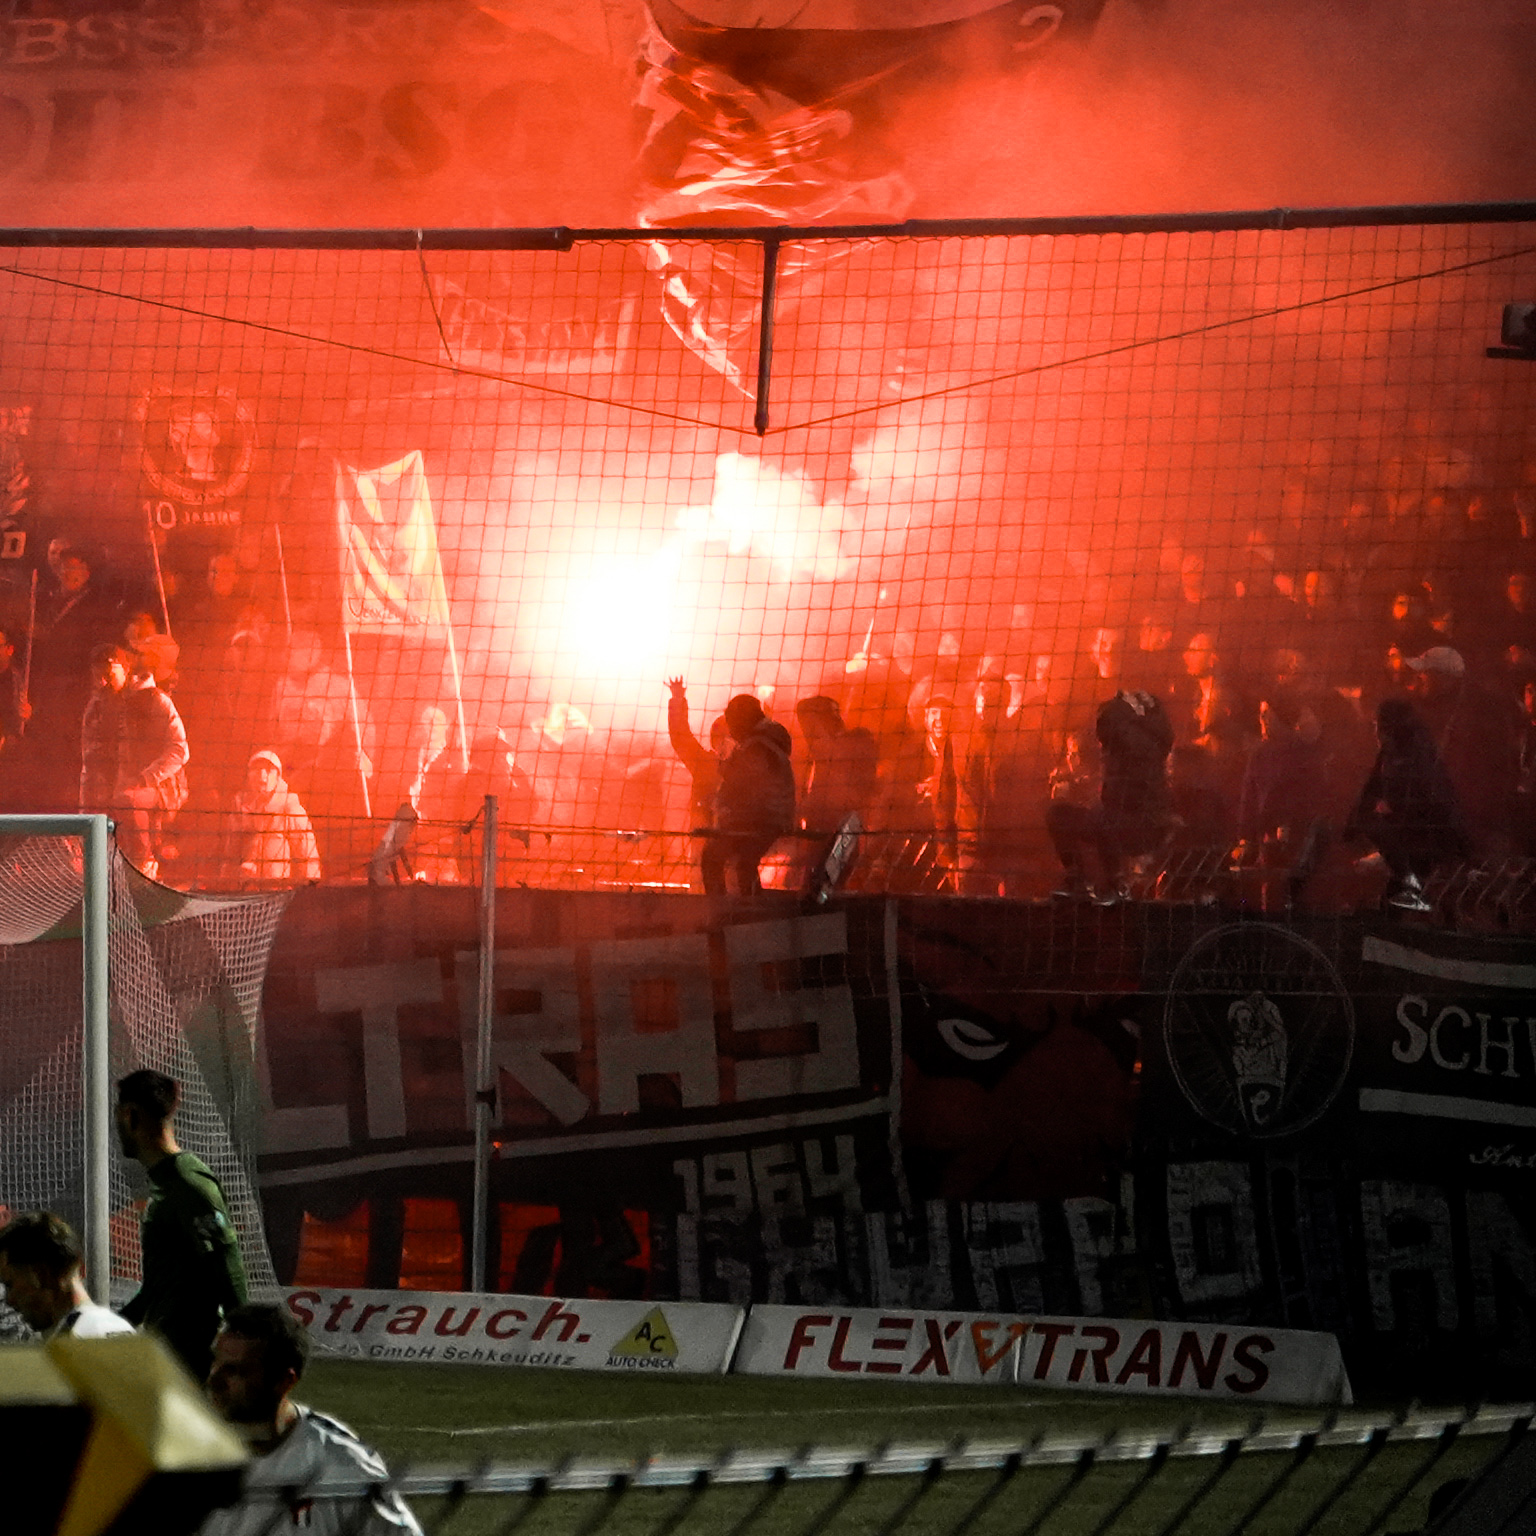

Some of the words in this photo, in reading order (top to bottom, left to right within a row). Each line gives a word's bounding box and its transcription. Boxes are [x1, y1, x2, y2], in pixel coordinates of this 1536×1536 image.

[1390, 994, 1536, 1081] SCH
[672, 1132, 861, 1216] 1964
[369, 1344, 434, 1360] GmbH
[442, 1347, 578, 1368] Schkeuditz
